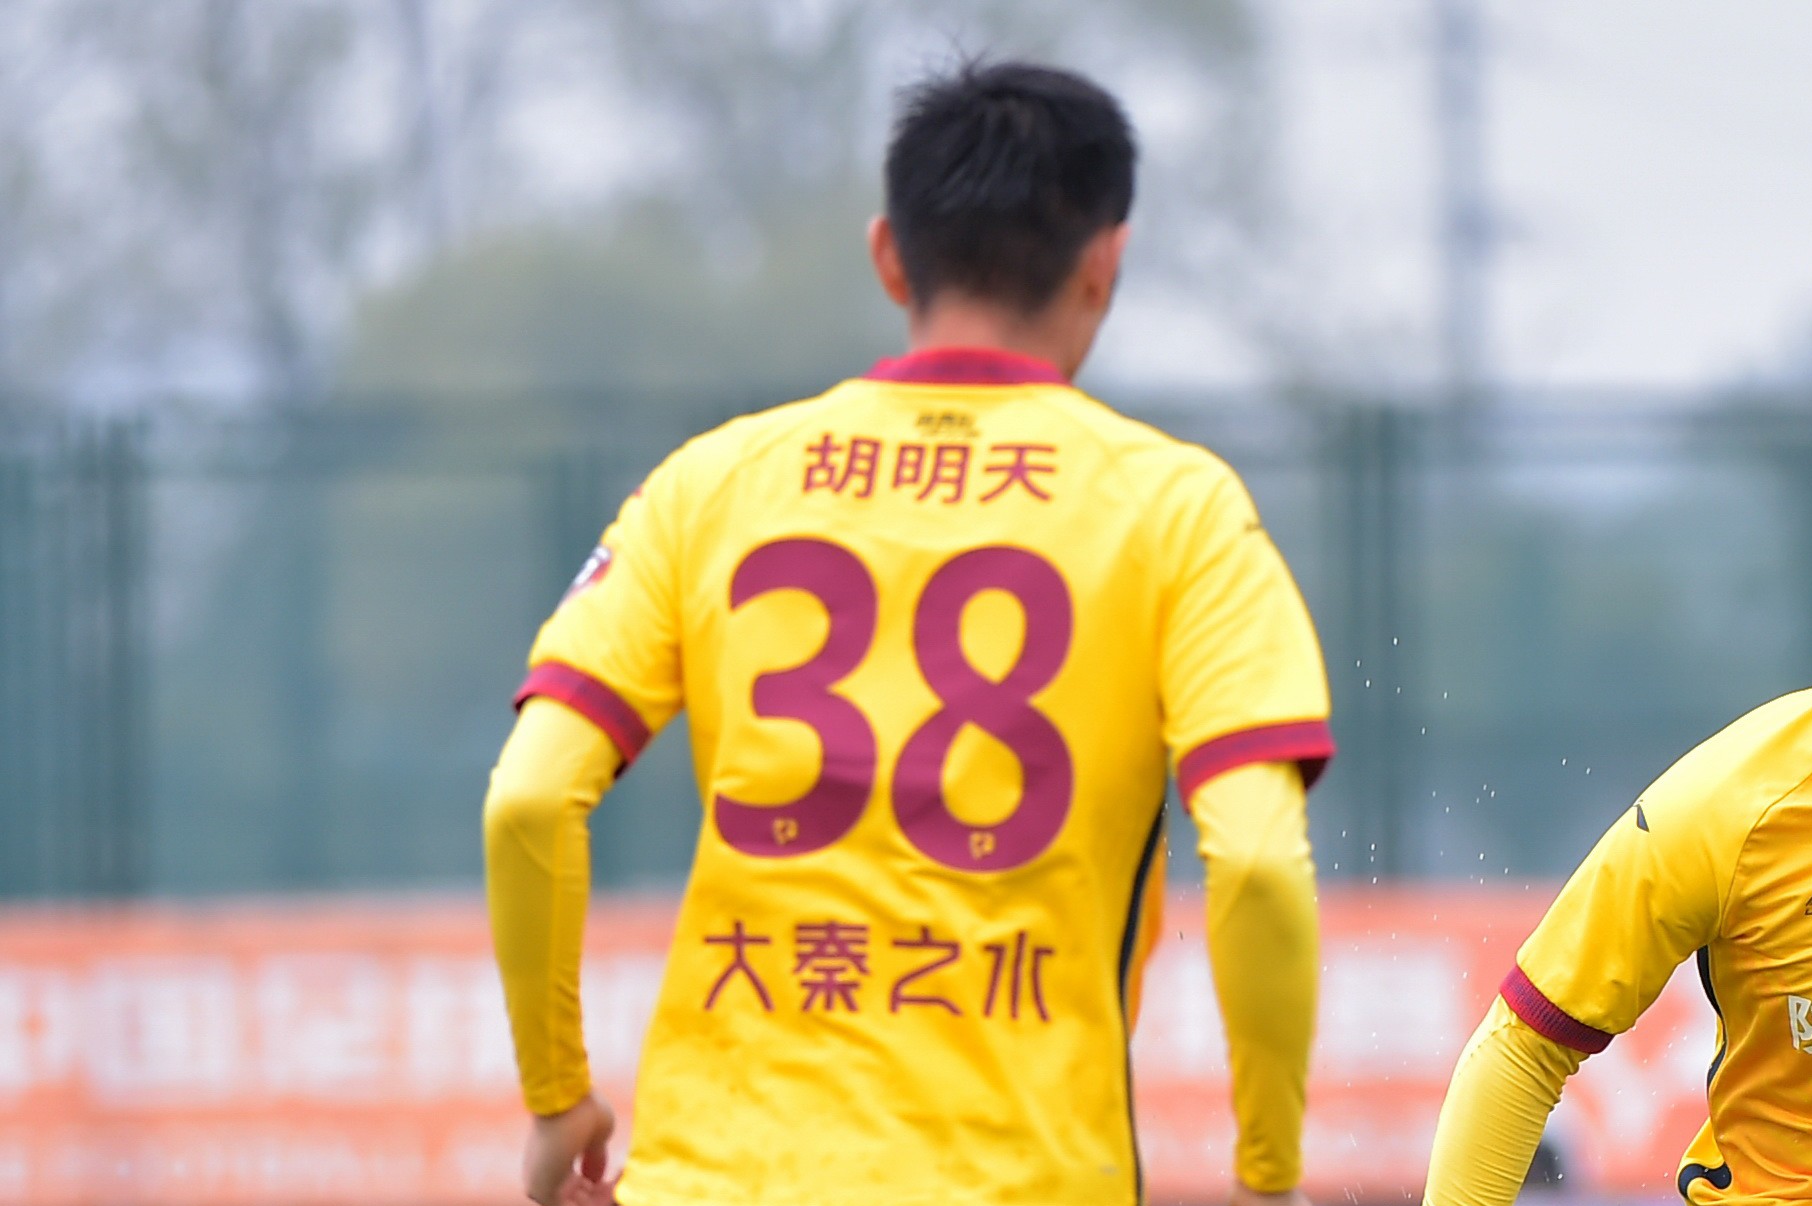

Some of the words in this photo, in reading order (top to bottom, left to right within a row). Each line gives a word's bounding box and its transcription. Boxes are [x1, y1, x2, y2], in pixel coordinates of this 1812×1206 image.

[802, 433, 1057, 504] 胡明天
[715, 534, 1074, 874] 38
[703, 919, 1056, 1023] 大秦之水
